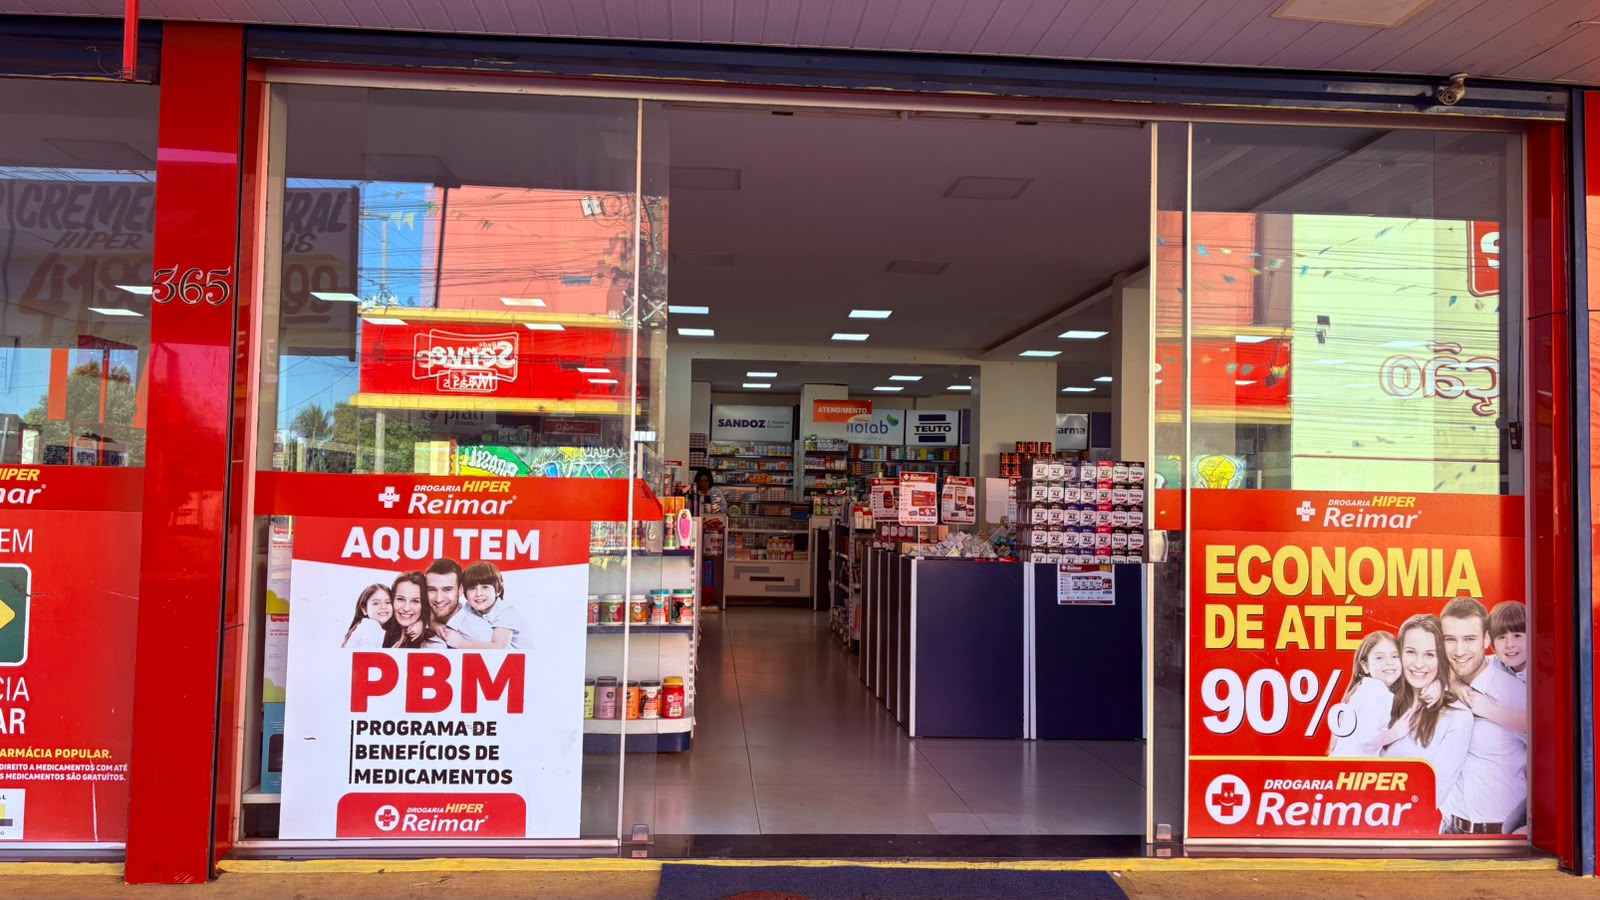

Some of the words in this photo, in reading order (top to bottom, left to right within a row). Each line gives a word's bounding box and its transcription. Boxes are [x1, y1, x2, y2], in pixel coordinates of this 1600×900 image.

[151, 264, 231, 306] 365
[818, 406, 868, 414] ATENDIMENTO
[718, 419, 766, 428] SANDOZ
[847, 420, 888, 434] iolab
[914, 425, 952, 433] TEUTO
[463, 480, 511, 493] HIPER
[1328, 499, 1370, 507] DROGARIA
[1372, 496, 1416, 508] HIPER
[341, 526, 443, 562] AQUI
[453, 529, 540, 560] TEM
[1206, 545, 1483, 598] ECONOMIA
[1205, 604, 1264, 650] DE
[1275, 595, 1363, 651] ATÉ
[351, 652, 525, 714] PBM
[1201, 668, 1357, 737] 90%
[356, 720, 467, 736] PROGRAMA
[473, 721, 497, 736] DE
[55, 748, 113, 759] POPULAR.
[355, 741, 470, 761] BENEFÍCIOS
[475, 745, 499, 761] DE
[0, 763, 28, 771] DIREITO
[36, 763, 95, 771] MEDICAMENTOS
[113, 762, 129, 771] ATÉ
[5, 773, 65, 781] MEDICAMENTOS
[66, 772, 82, 781] SÃO
[82, 772, 127, 781] GRATUÍTOS.
[354, 768, 513, 785] MEDICAMENTOS
[1264, 778, 1333, 790] DROGARIA
[1335, 772, 1409, 791] HIPER
[445, 803, 484, 814] HIPER
